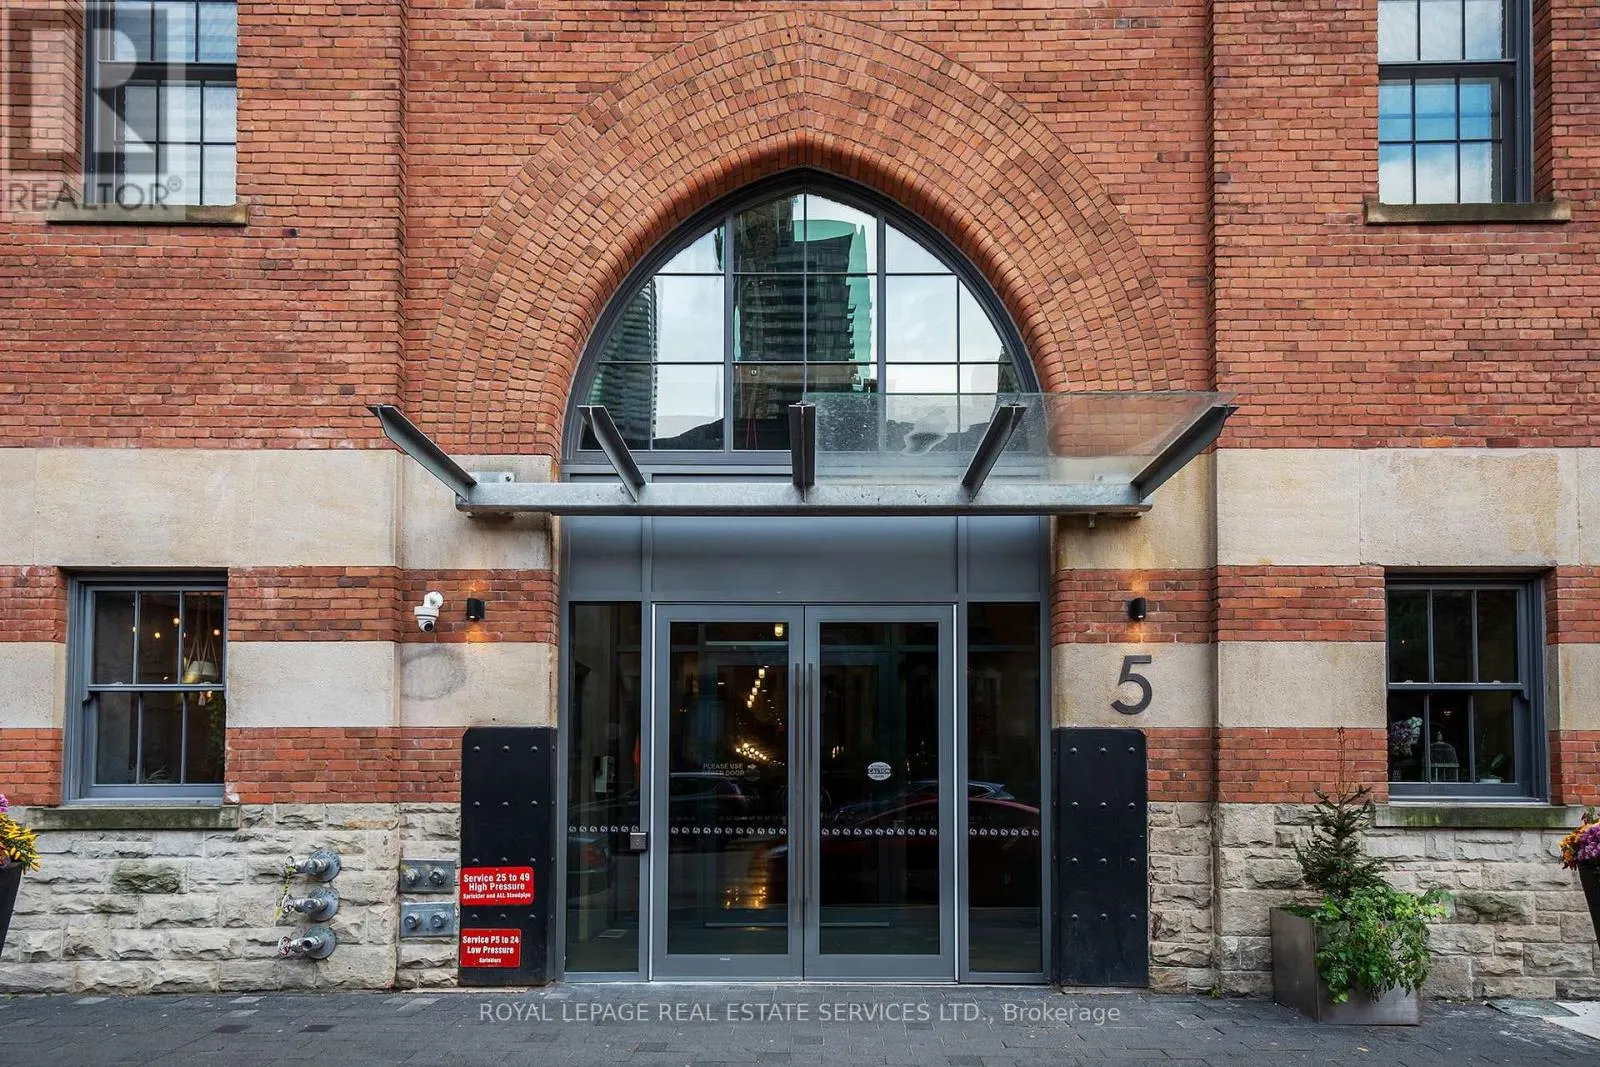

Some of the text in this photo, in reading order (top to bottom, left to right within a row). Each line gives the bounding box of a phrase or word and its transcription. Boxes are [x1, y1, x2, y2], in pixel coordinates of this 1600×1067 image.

[1110, 655, 1152, 715] 5
[464, 874, 494, 882] Service
[496, 873, 507, 881] 25
[469, 883, 488, 892] High
